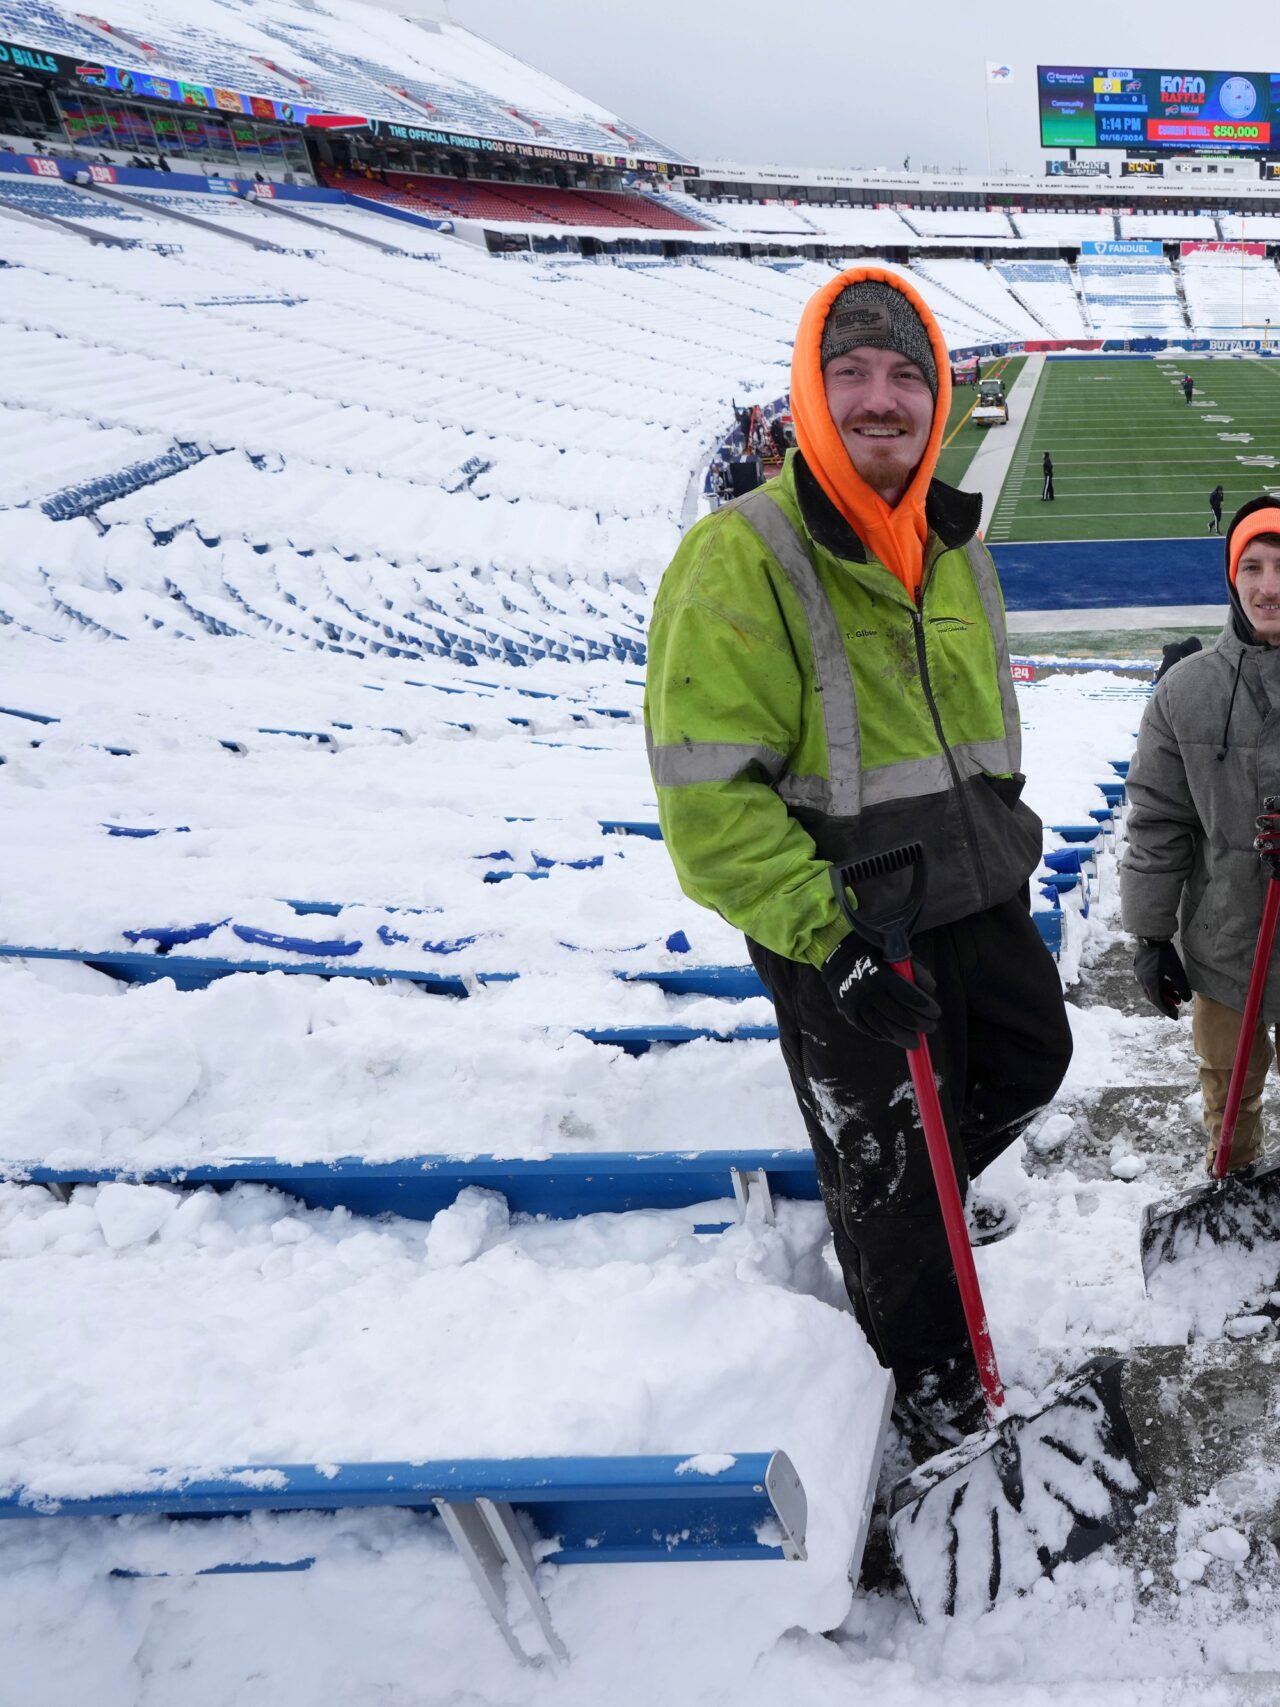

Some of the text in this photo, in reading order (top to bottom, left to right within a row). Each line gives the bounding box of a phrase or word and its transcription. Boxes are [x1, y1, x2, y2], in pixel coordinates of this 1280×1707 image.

[10, 47, 58, 72] BILLS
[1160, 75, 1206, 93] 50/50
[1161, 92, 1205, 104] RAFFLE
[1101, 118, 1141, 131] 1:14 PM
[1213, 125, 1259, 139] $50,000
[388, 124, 589, 164] THE OFFICIAL FINGER FOOD OF THE BUFFALO BILLS
[33, 158, 60, 177] 133
[1066, 161, 1106, 169] IMAGINE
[1128, 161, 1158, 172] HUNT
[89, 164, 113, 183] 134
[254, 183, 273, 198] 135
[1108, 244, 1150, 253] FANDUEL
[1209, 340, 1256, 351] BUFFALO
[839, 954, 872, 999] NINJA
